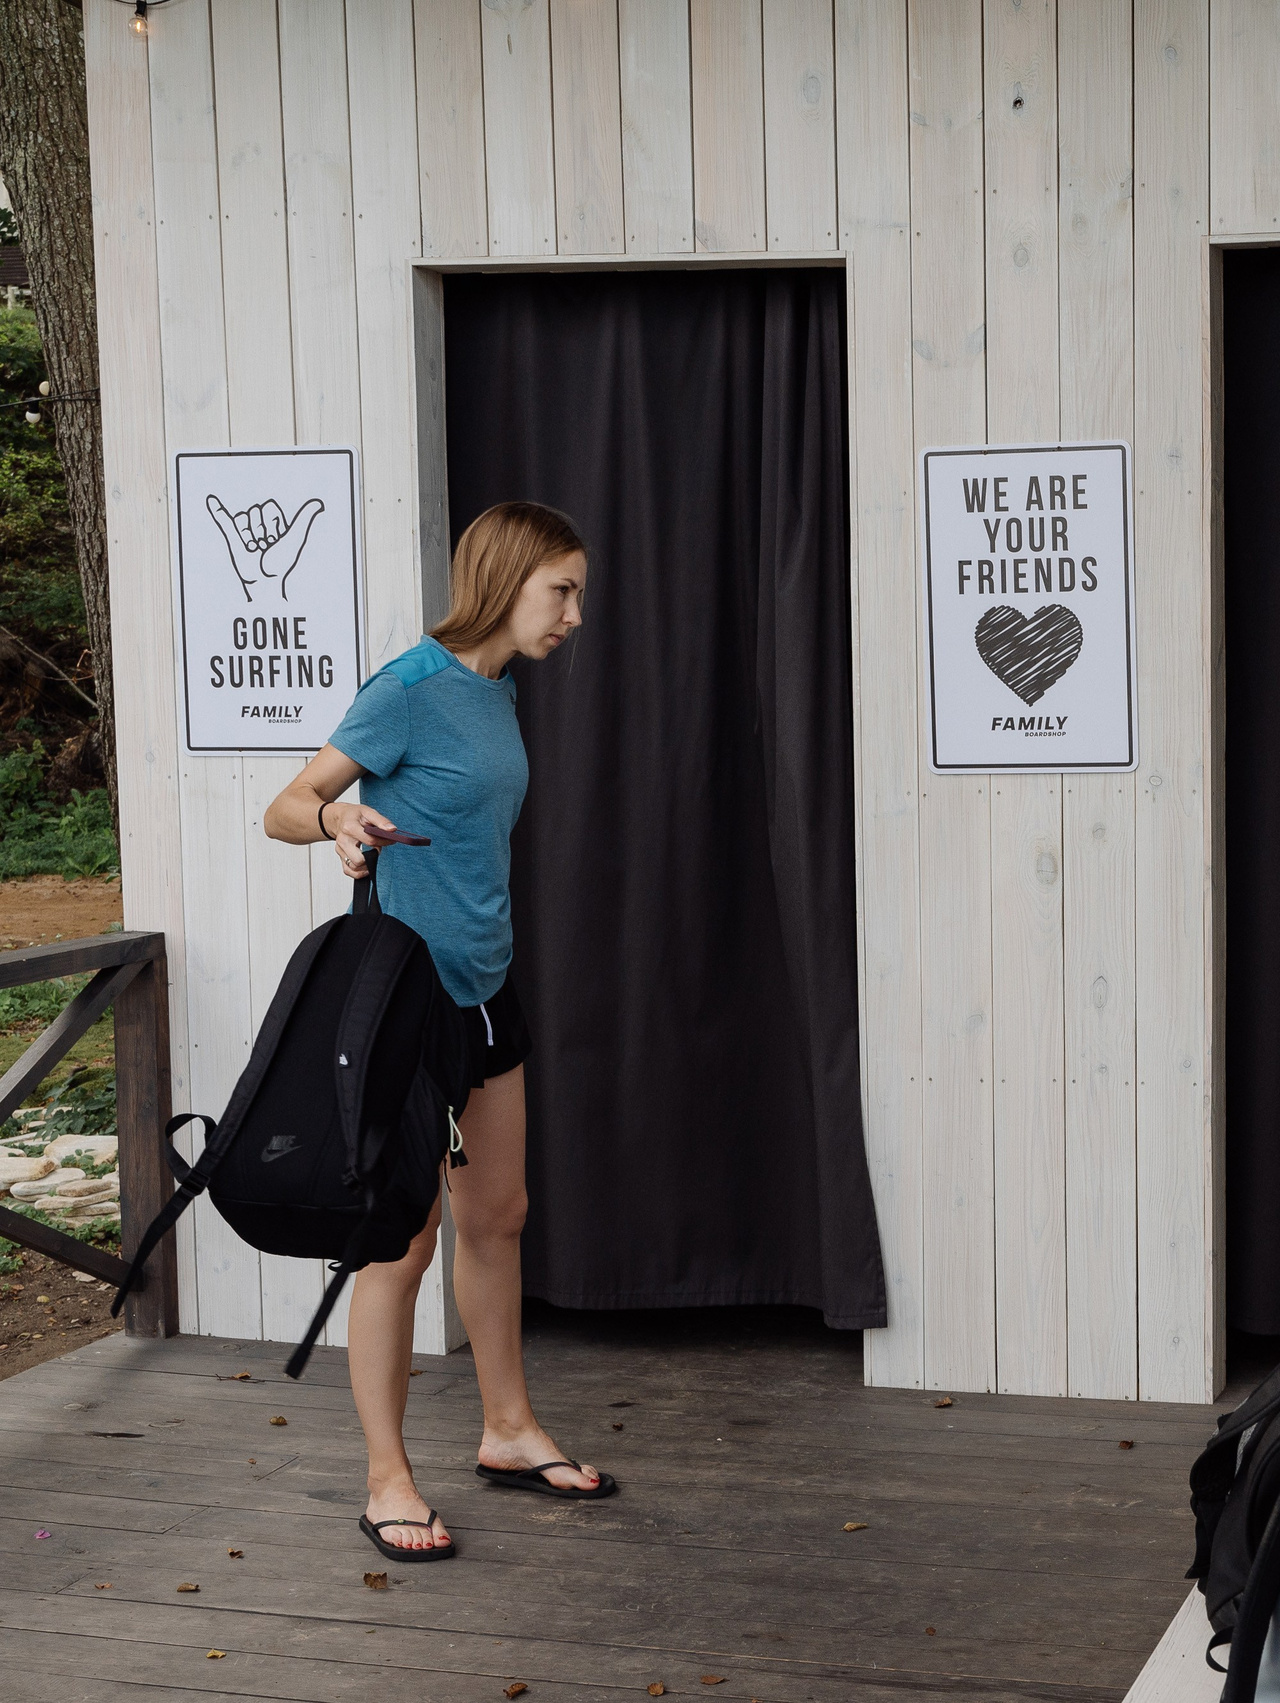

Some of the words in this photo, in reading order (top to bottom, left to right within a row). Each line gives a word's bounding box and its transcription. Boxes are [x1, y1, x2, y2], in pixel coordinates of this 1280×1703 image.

[962, 477, 1009, 513] WE
[1025, 474, 1088, 512] ARE
[983, 516, 1069, 553] YOUR
[957, 556, 1098, 595] FRIENDS
[233, 616, 308, 651] GONE
[210, 654, 333, 688] SURFING
[241, 705, 304, 718] FAMILY
[991, 715, 1069, 731] FAMILY
